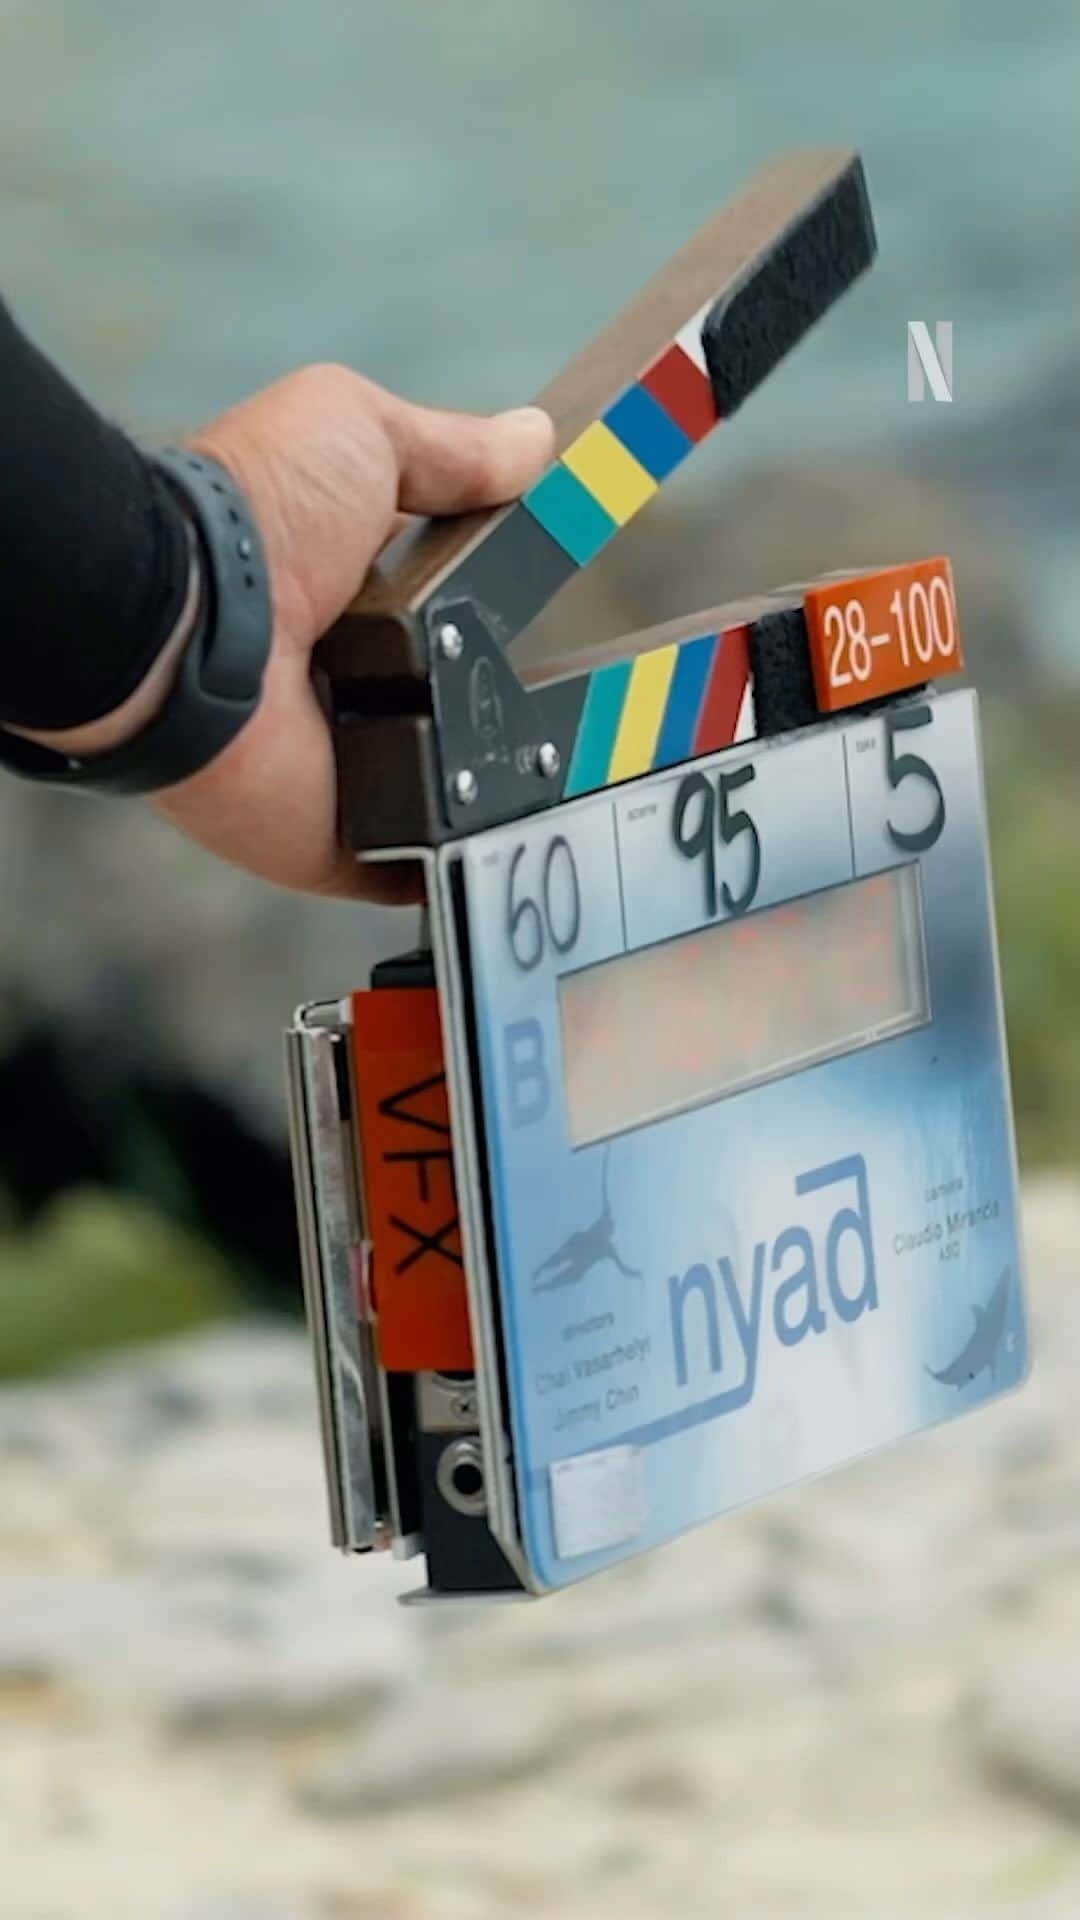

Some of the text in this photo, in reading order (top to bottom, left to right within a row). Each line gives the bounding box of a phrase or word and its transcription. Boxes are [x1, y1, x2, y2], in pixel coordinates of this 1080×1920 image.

[823, 575, 955, 687] 28-100
[672, 763, 762, 918] 95
[883, 704, 946, 853] 5
[507, 834, 581, 972] 60
[504, 1016, 551, 1129] B
[378, 1073, 464, 1275] VFX
[666, 1153, 880, 1404] nyad
